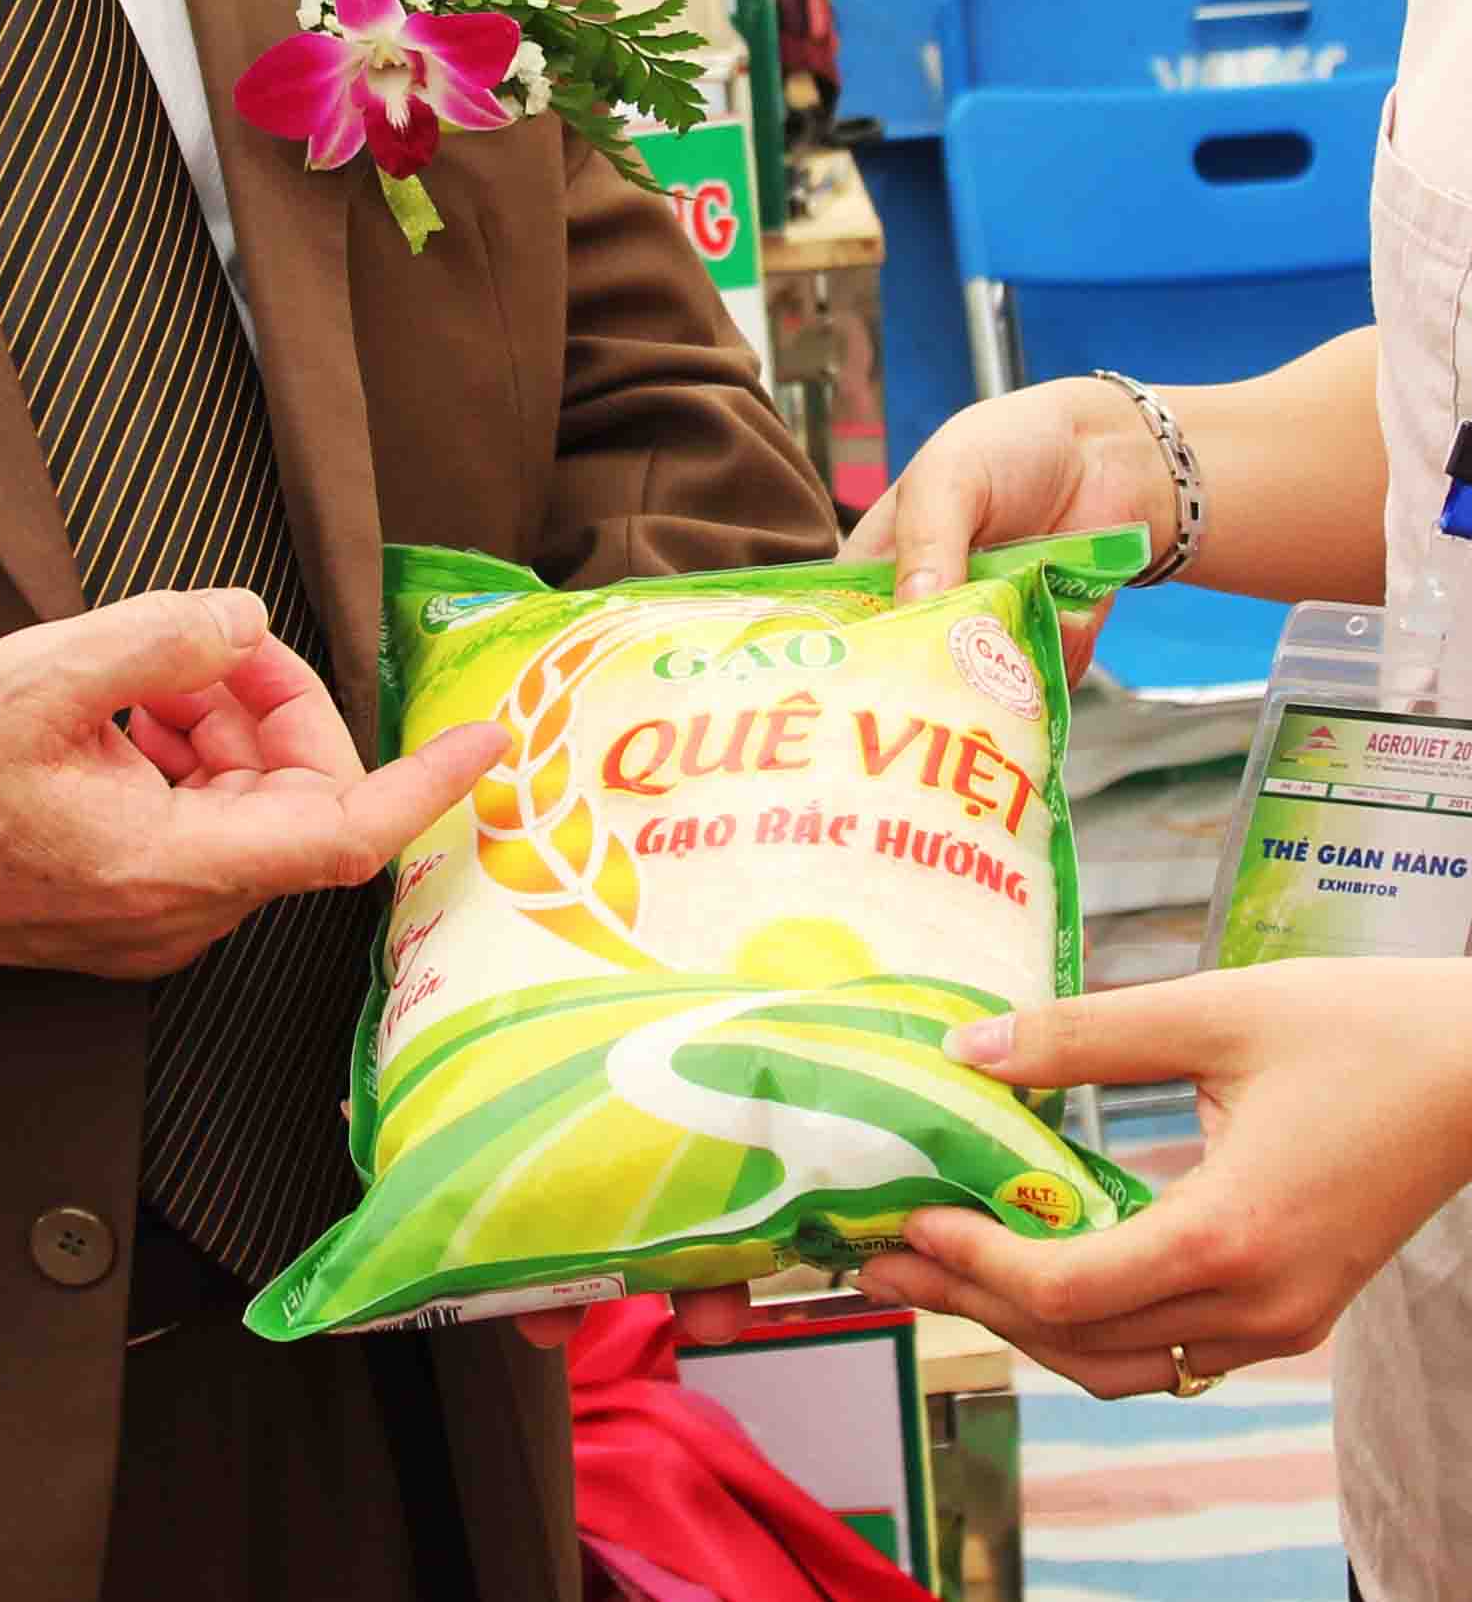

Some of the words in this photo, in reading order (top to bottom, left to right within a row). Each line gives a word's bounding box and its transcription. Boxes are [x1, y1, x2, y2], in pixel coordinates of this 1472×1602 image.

[652, 631, 848, 681] GẠO
[600, 689, 824, 797] QUÊ
[849, 708, 1042, 837] VIỆT
[1365, 733, 1451, 760] AGROVIET
[634, 813, 738, 859] GẠO
[874, 817, 1029, 906] HƯƠNG
[1317, 844, 1385, 870] GIAN
[1317, 878, 1399, 898] EXHIBITOR
